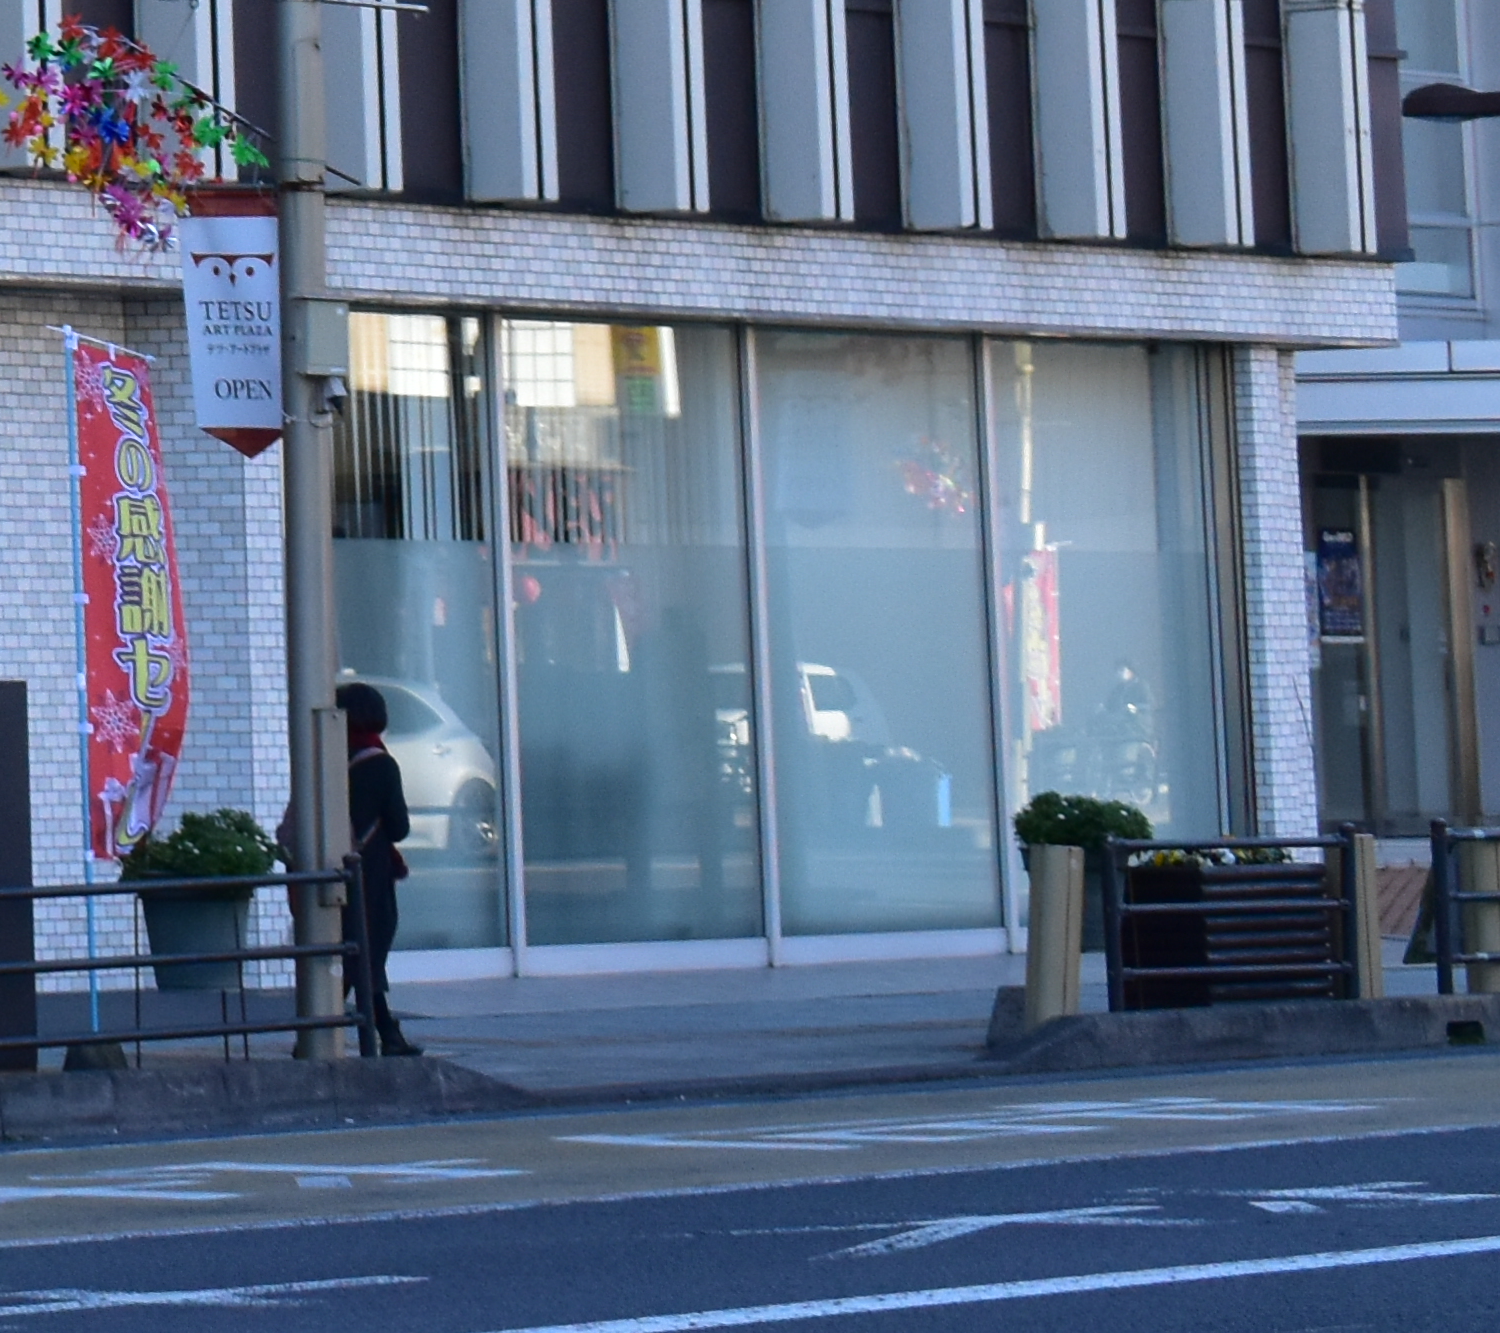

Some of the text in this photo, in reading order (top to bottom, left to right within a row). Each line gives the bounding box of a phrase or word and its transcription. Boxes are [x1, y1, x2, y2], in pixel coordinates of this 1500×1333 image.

[198, 300, 272, 322] TETSU
[203, 323, 274, 337] ART PLAZA
[214, 378, 273, 400] OPEN
